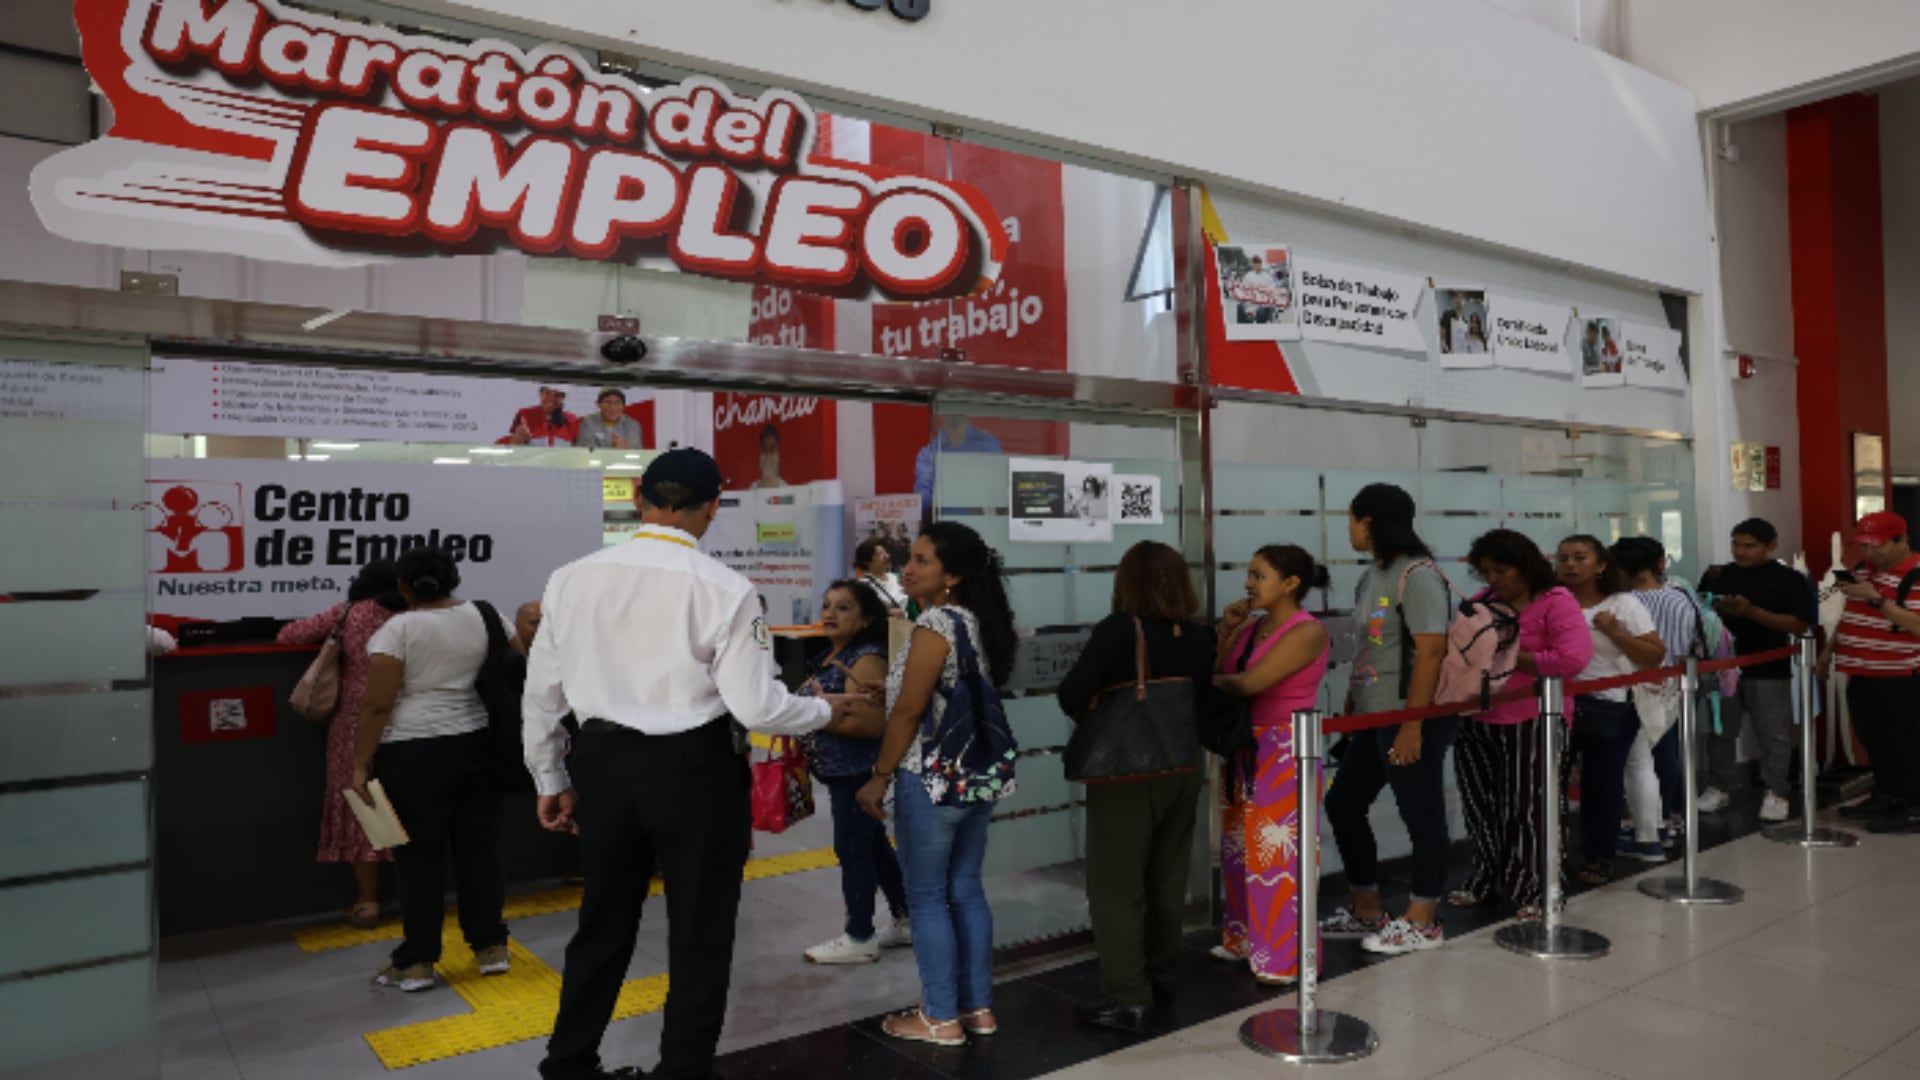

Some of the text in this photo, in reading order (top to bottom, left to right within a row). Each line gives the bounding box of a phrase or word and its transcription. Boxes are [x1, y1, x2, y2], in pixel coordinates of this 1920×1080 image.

[146, 0, 794, 162] Maratón del
[298, 105, 962, 284] EMPLEO
[751, 287, 792, 324] odo
[879, 325, 912, 355] tu
[918, 287, 1042, 347] trabajo
[254, 484, 410, 522] Centro
[254, 529, 314, 568] de
[157, 578, 262, 596] Nuestra
[271, 576, 341, 593] meta,
